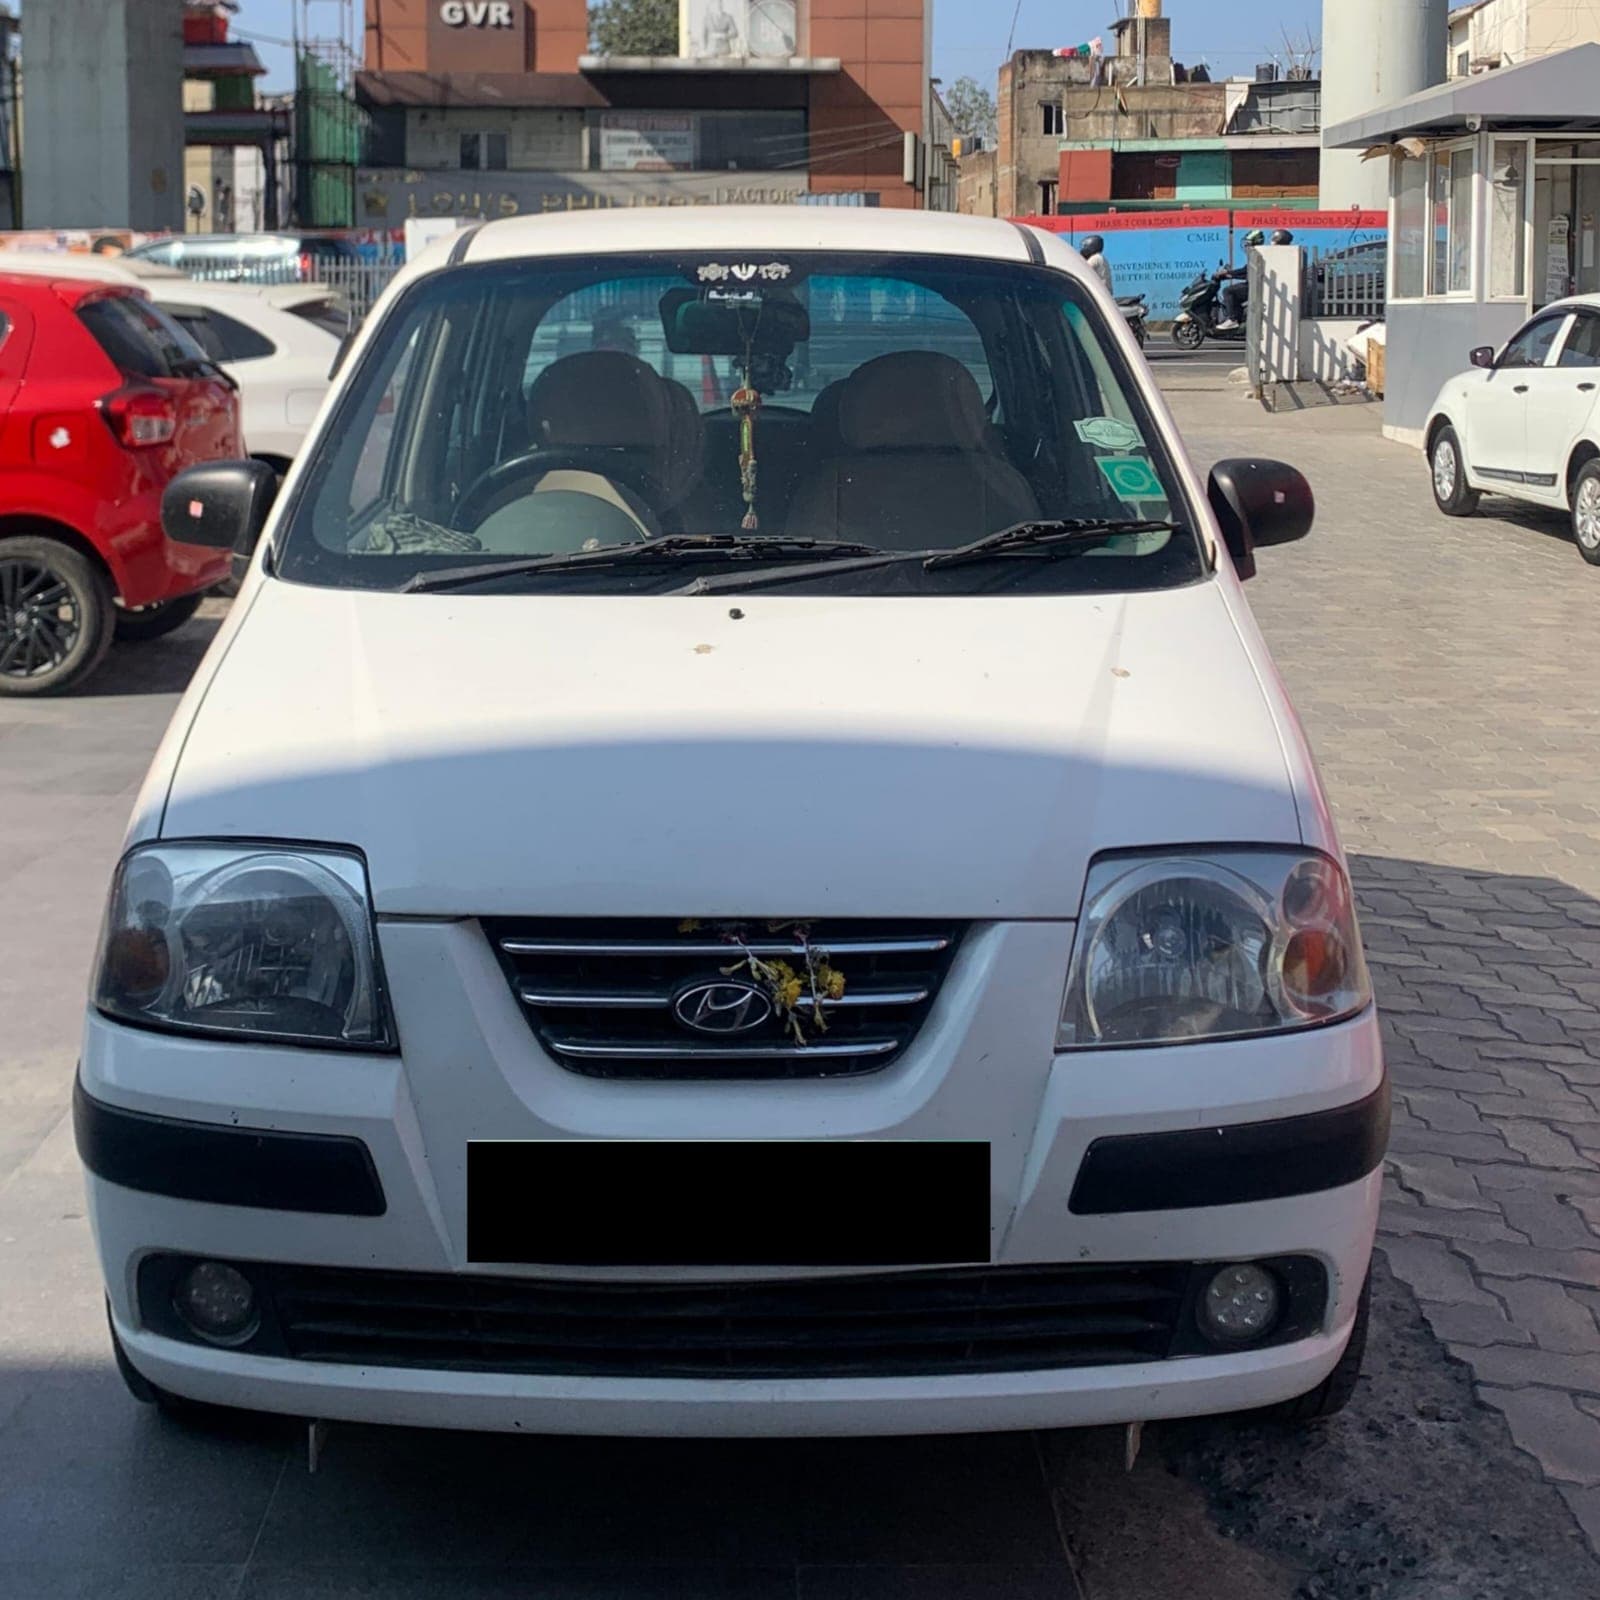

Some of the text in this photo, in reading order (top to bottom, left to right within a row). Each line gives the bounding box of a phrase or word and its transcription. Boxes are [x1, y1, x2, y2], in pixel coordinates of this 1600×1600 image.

[441, 1, 512, 25] GVR
[1187, 232, 1223, 243] CMRL
[1112, 261, 1206, 270] ONVENIENCE TODAY
